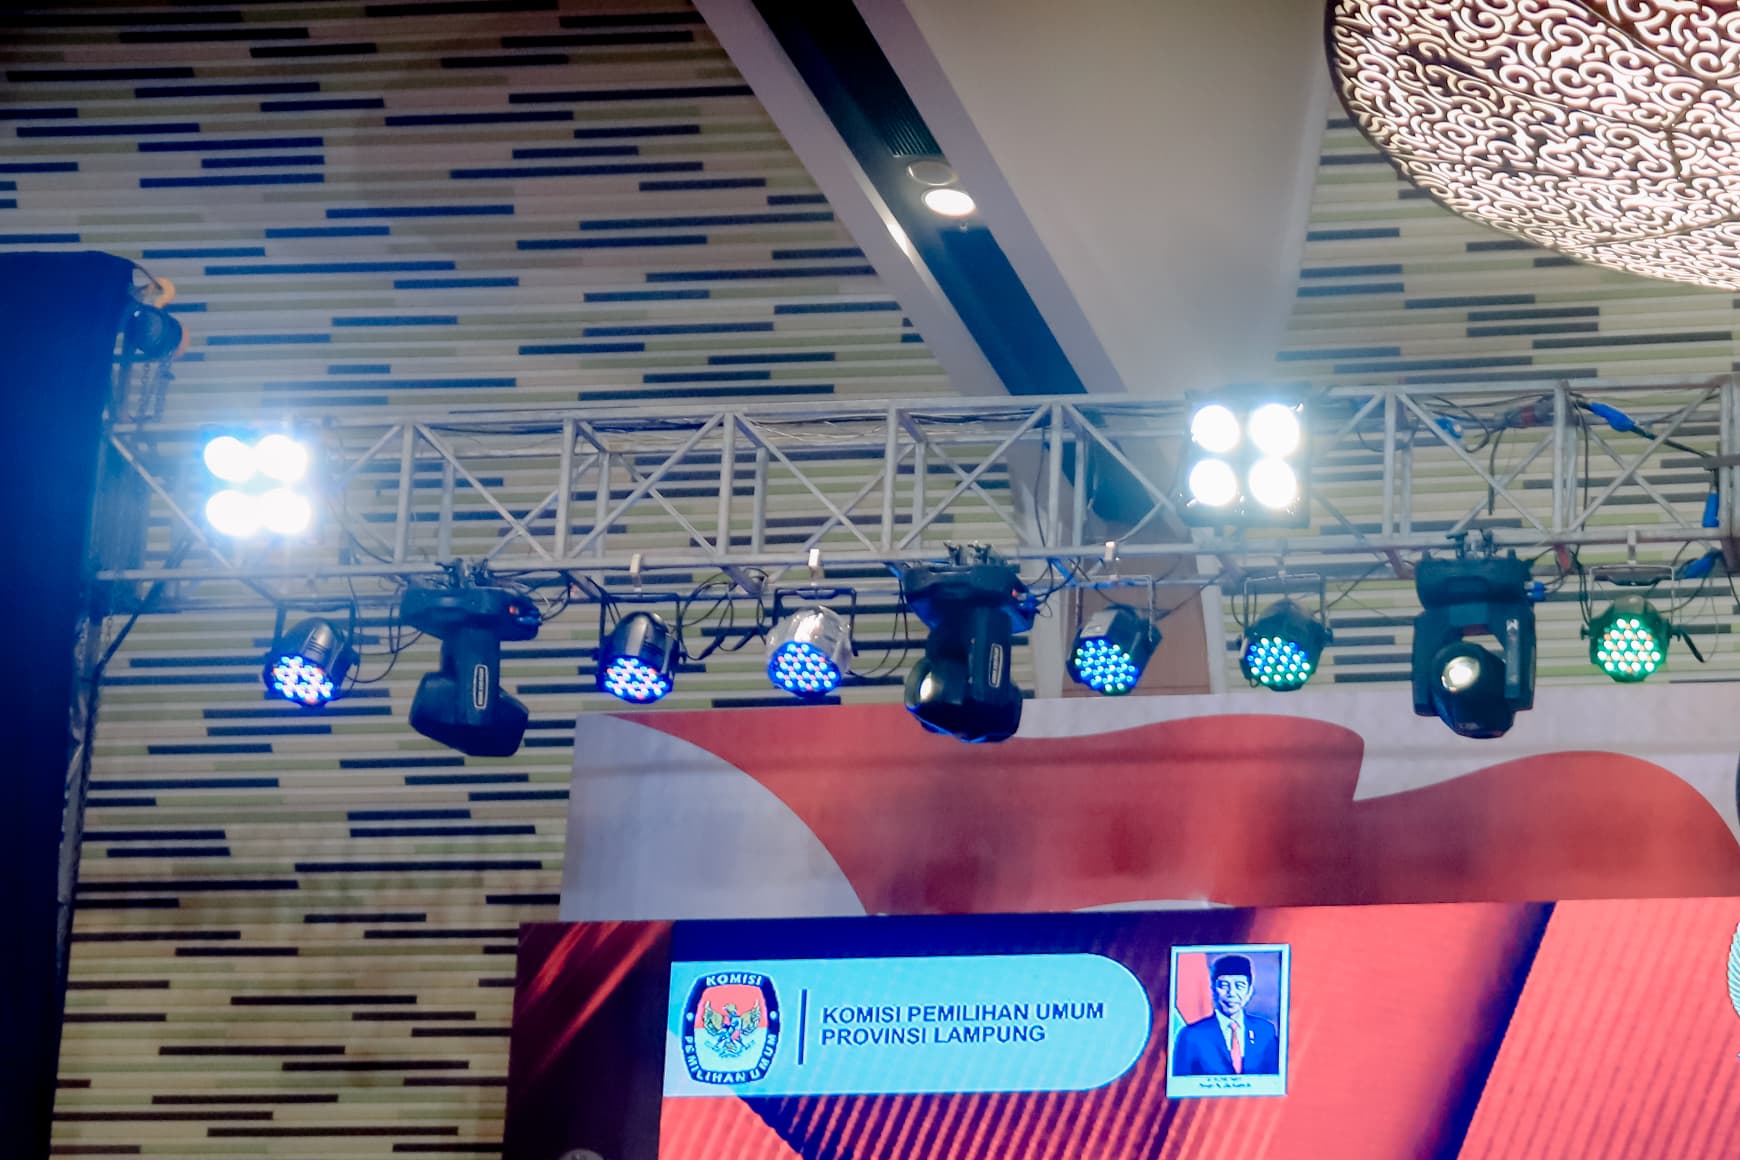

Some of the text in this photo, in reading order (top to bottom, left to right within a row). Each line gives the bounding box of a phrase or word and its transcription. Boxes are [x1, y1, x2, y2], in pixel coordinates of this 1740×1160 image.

[706, 974, 762, 986] KOMISI
[821, 1001, 1105, 1024] KOMISI PEMILIHAN UMUM
[821, 1024, 1047, 1045] PROVINSI LAMPUNG
[684, 1033, 777, 1083] PEMILIHAN UMUM
